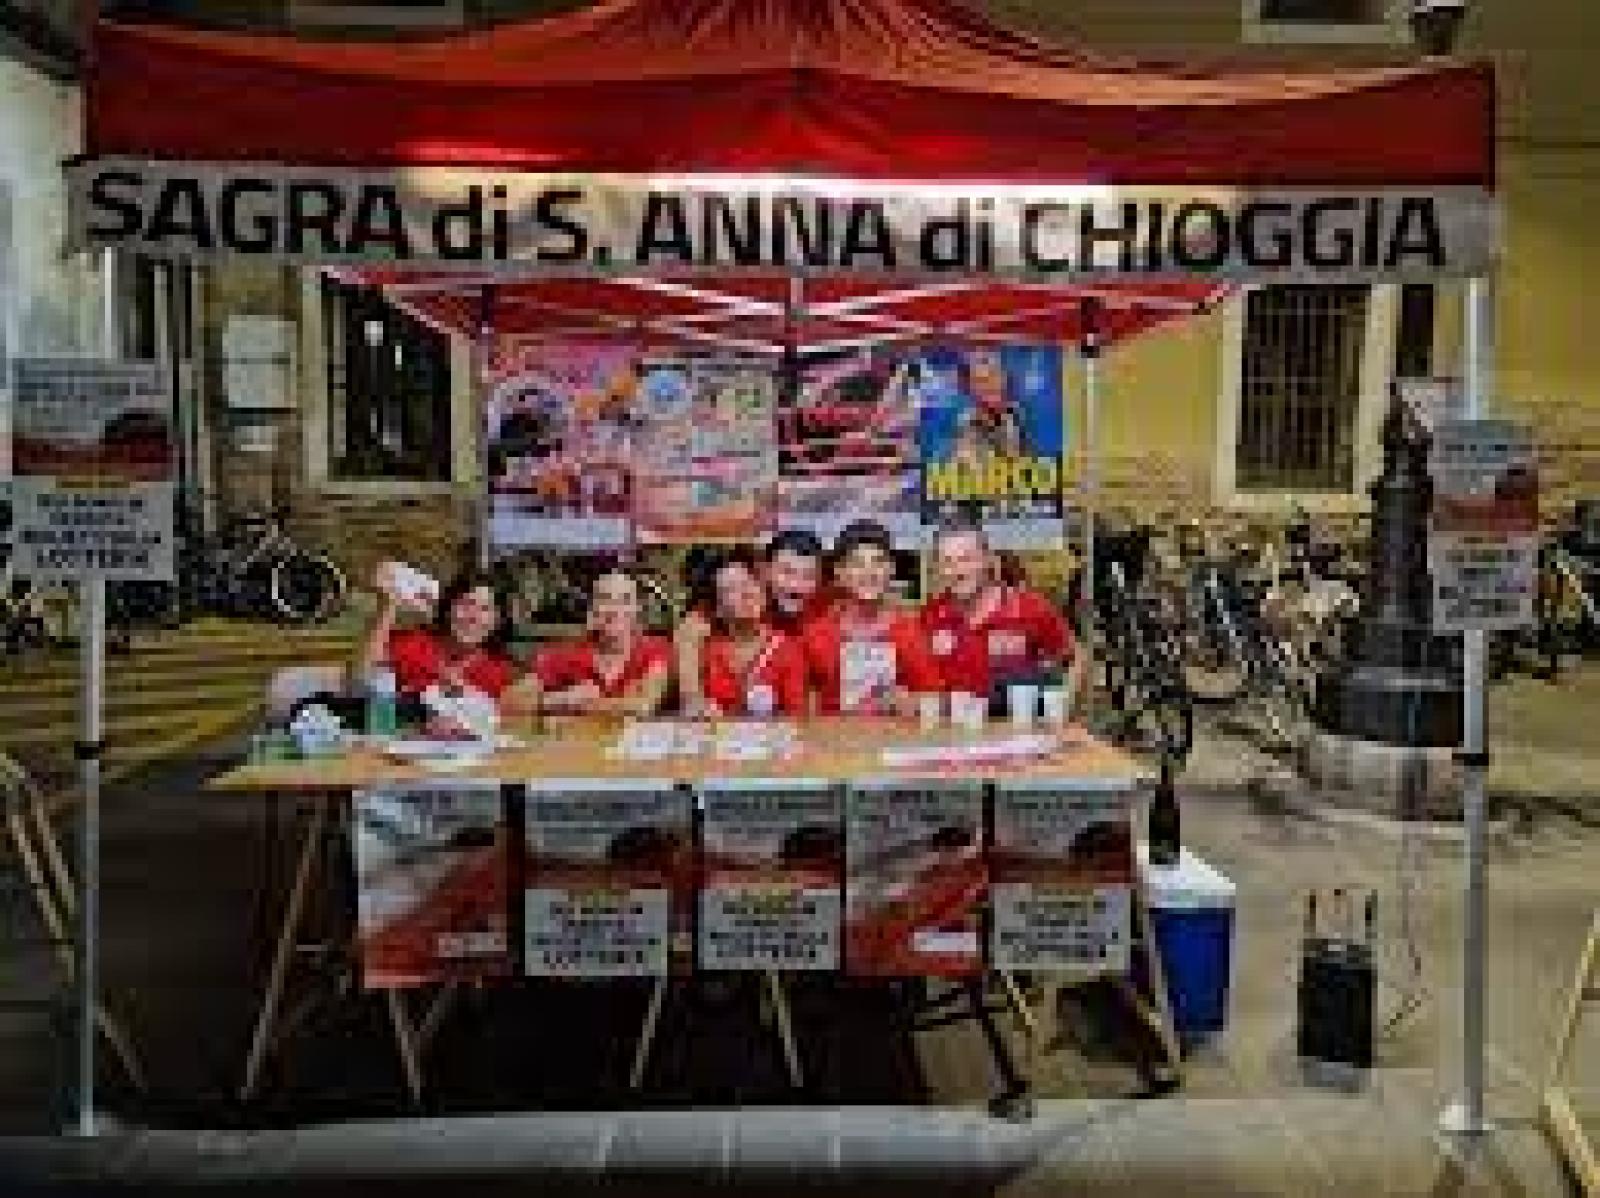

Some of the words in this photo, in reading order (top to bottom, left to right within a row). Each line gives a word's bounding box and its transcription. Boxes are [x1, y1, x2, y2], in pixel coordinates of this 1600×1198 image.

[86, 172, 408, 260] SAGRA
[432, 184, 507, 260] di
[533, 190, 612, 266] S.
[635, 191, 897, 266] ANNA
[918, 198, 995, 272] di
[1018, 197, 1446, 273] CHIOGGIA
